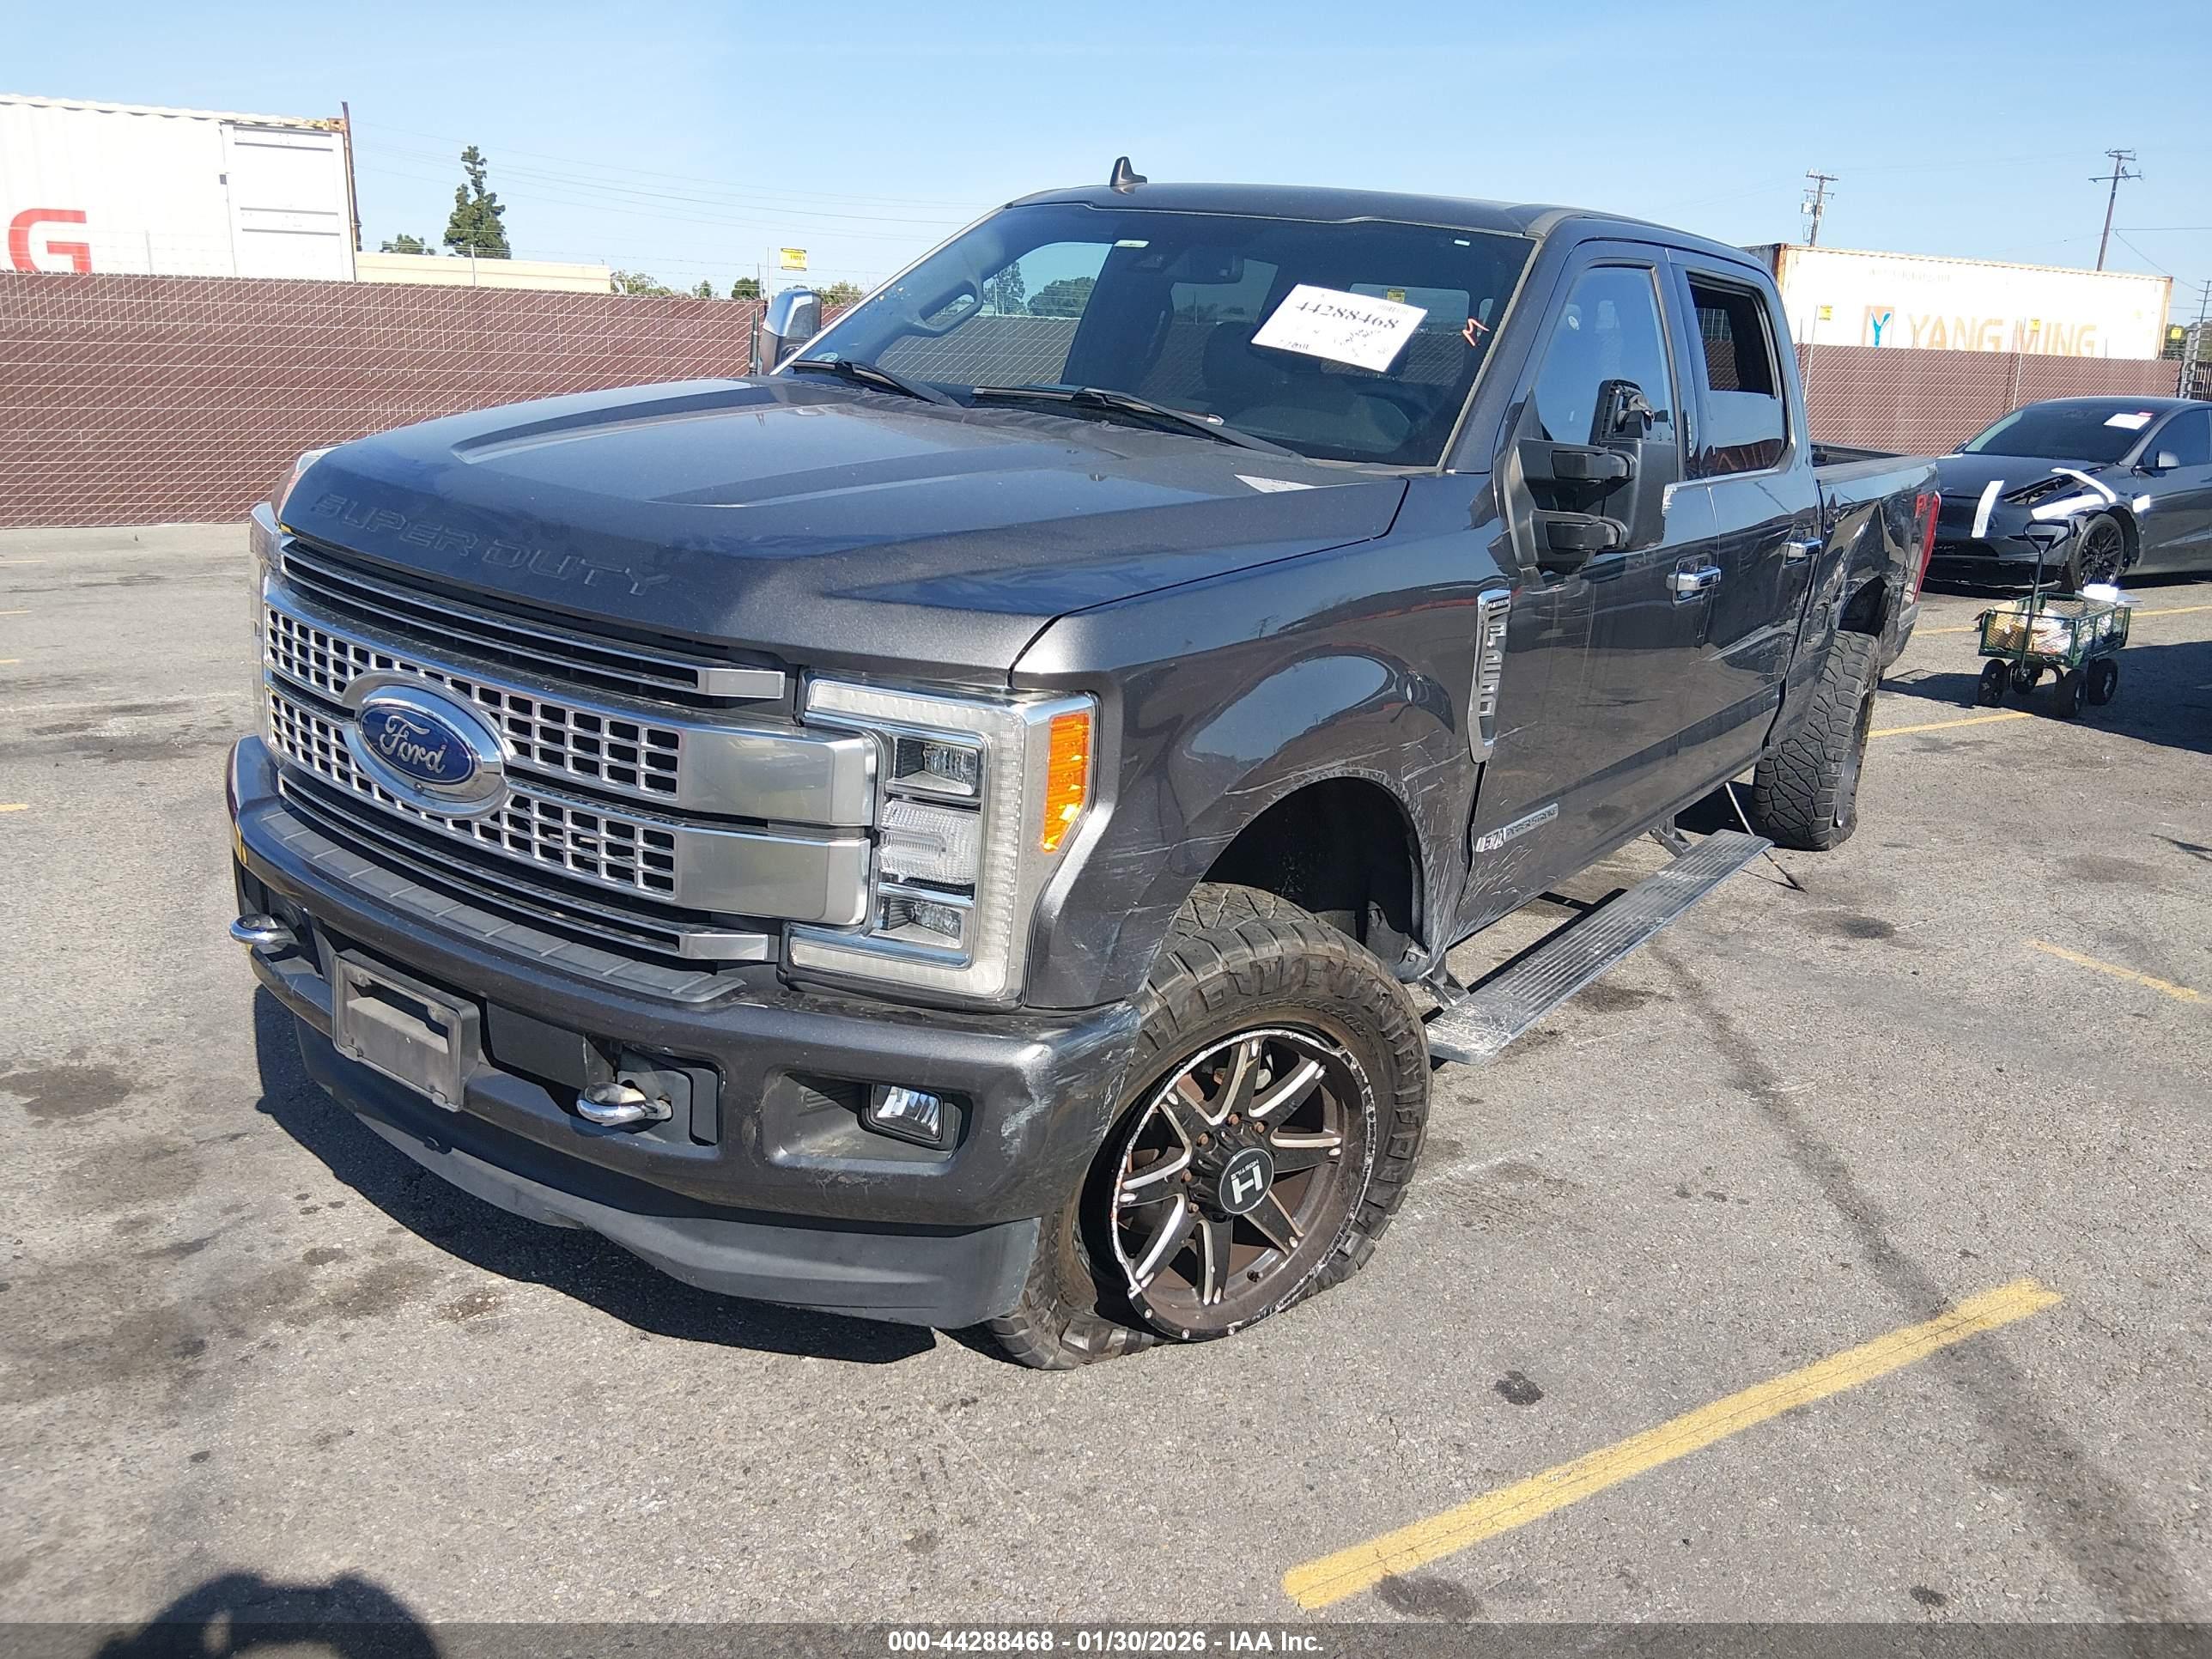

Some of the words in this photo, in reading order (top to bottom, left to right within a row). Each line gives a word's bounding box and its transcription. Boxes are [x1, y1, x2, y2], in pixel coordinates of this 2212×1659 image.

[8, 208, 92, 273] G
[1295, 301, 1400, 330] 44288468
[1907, 313, 2003, 353] YANG
[2012, 319, 2097, 358] MING
[311, 493, 481, 556] SUPER
[482, 538, 672, 597] DUTY
[380, 715, 447, 774] Ford
[1231, 1158, 1260, 1181] HOSTILE
